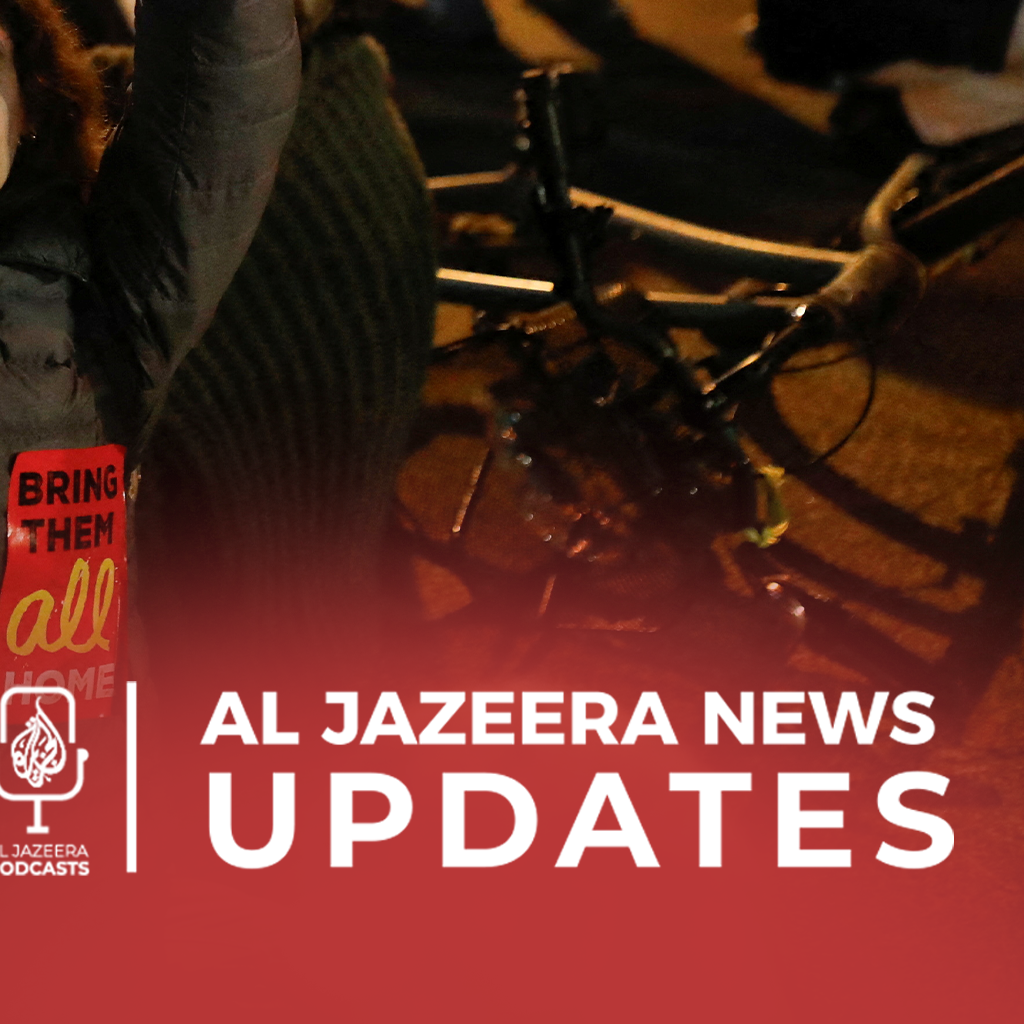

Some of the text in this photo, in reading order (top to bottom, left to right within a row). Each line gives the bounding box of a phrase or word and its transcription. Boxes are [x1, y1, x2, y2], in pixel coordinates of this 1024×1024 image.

[18, 464, 118, 507] BRING
[21, 512, 115, 554] THEM
[6, 557, 116, 657] all
[2, 663, 116, 706] HOME
